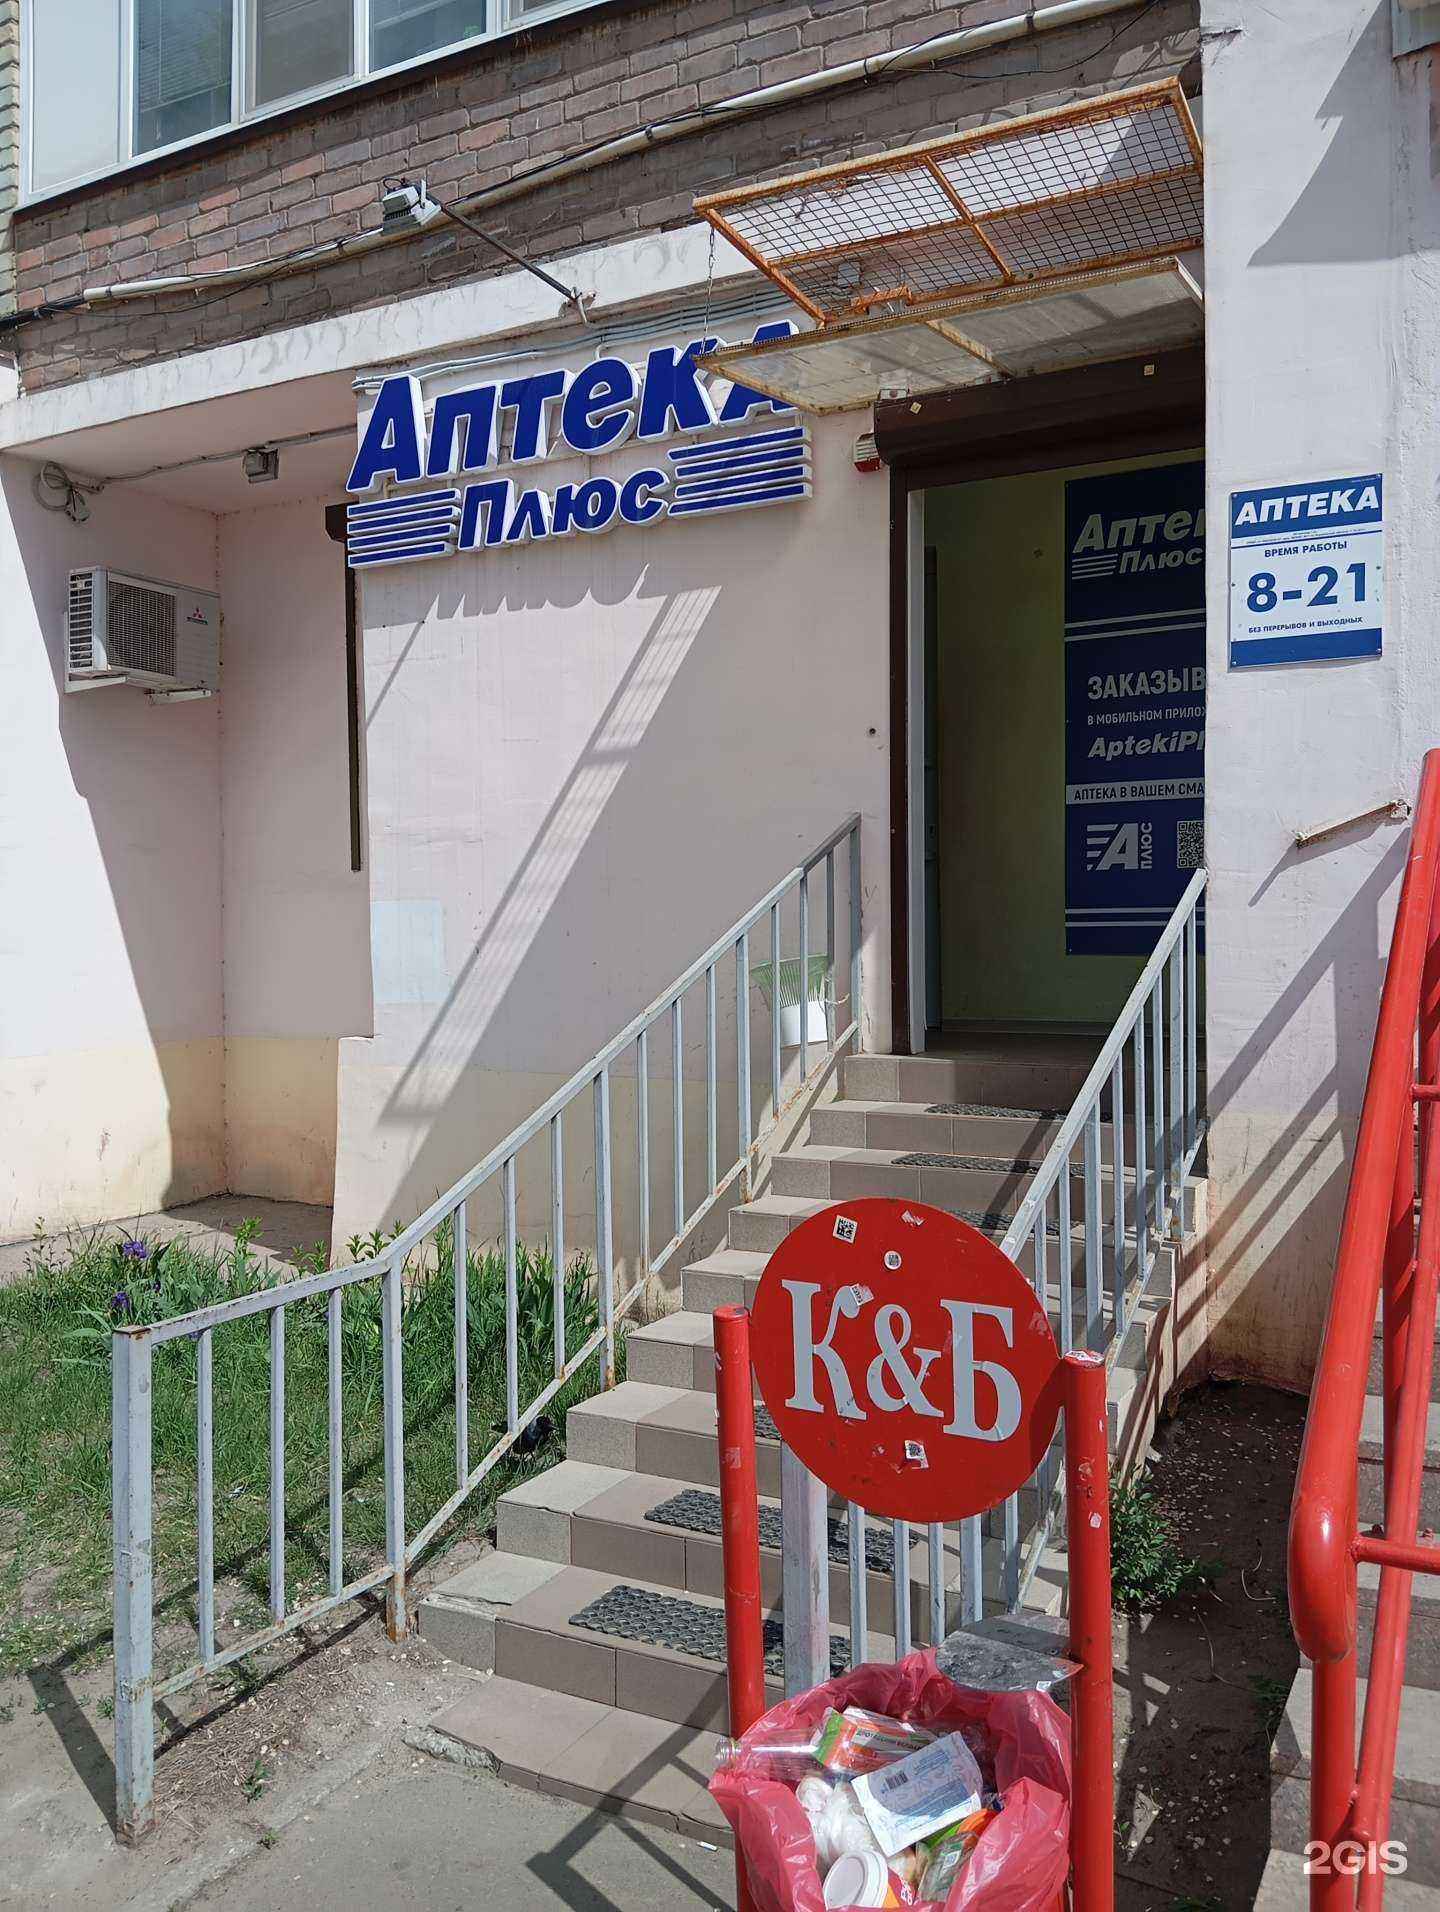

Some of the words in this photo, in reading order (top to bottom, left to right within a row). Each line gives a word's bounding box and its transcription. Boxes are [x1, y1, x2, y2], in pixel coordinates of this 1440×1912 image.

[457, 467, 669, 552] Плюс
[1234, 485, 1379, 526] АПТЕКА
[1119, 547, 1204, 574] Плюс
[1264, 546, 1299, 558] ВРЕМЯ
[1302, 540, 1348, 555] РАБОТЫ
[1246, 562, 1366, 613] 8-21
[1248, 626, 1262, 634] БЕЗ
[1263, 622, 1307, 633] ПЕРЕРЫВОВ
[1317, 616, 1364, 627] ВЫХОДНЫХ
[1096, 709, 1163, 725] МОБИЛЬНОМ
[1074, 788, 1117, 801] АПТЕКА
[1120, 786, 1128, 798] В
[1131, 784, 1175, 798] ВАШЕМ
[781, 1278, 1022, 1442] К&Б
